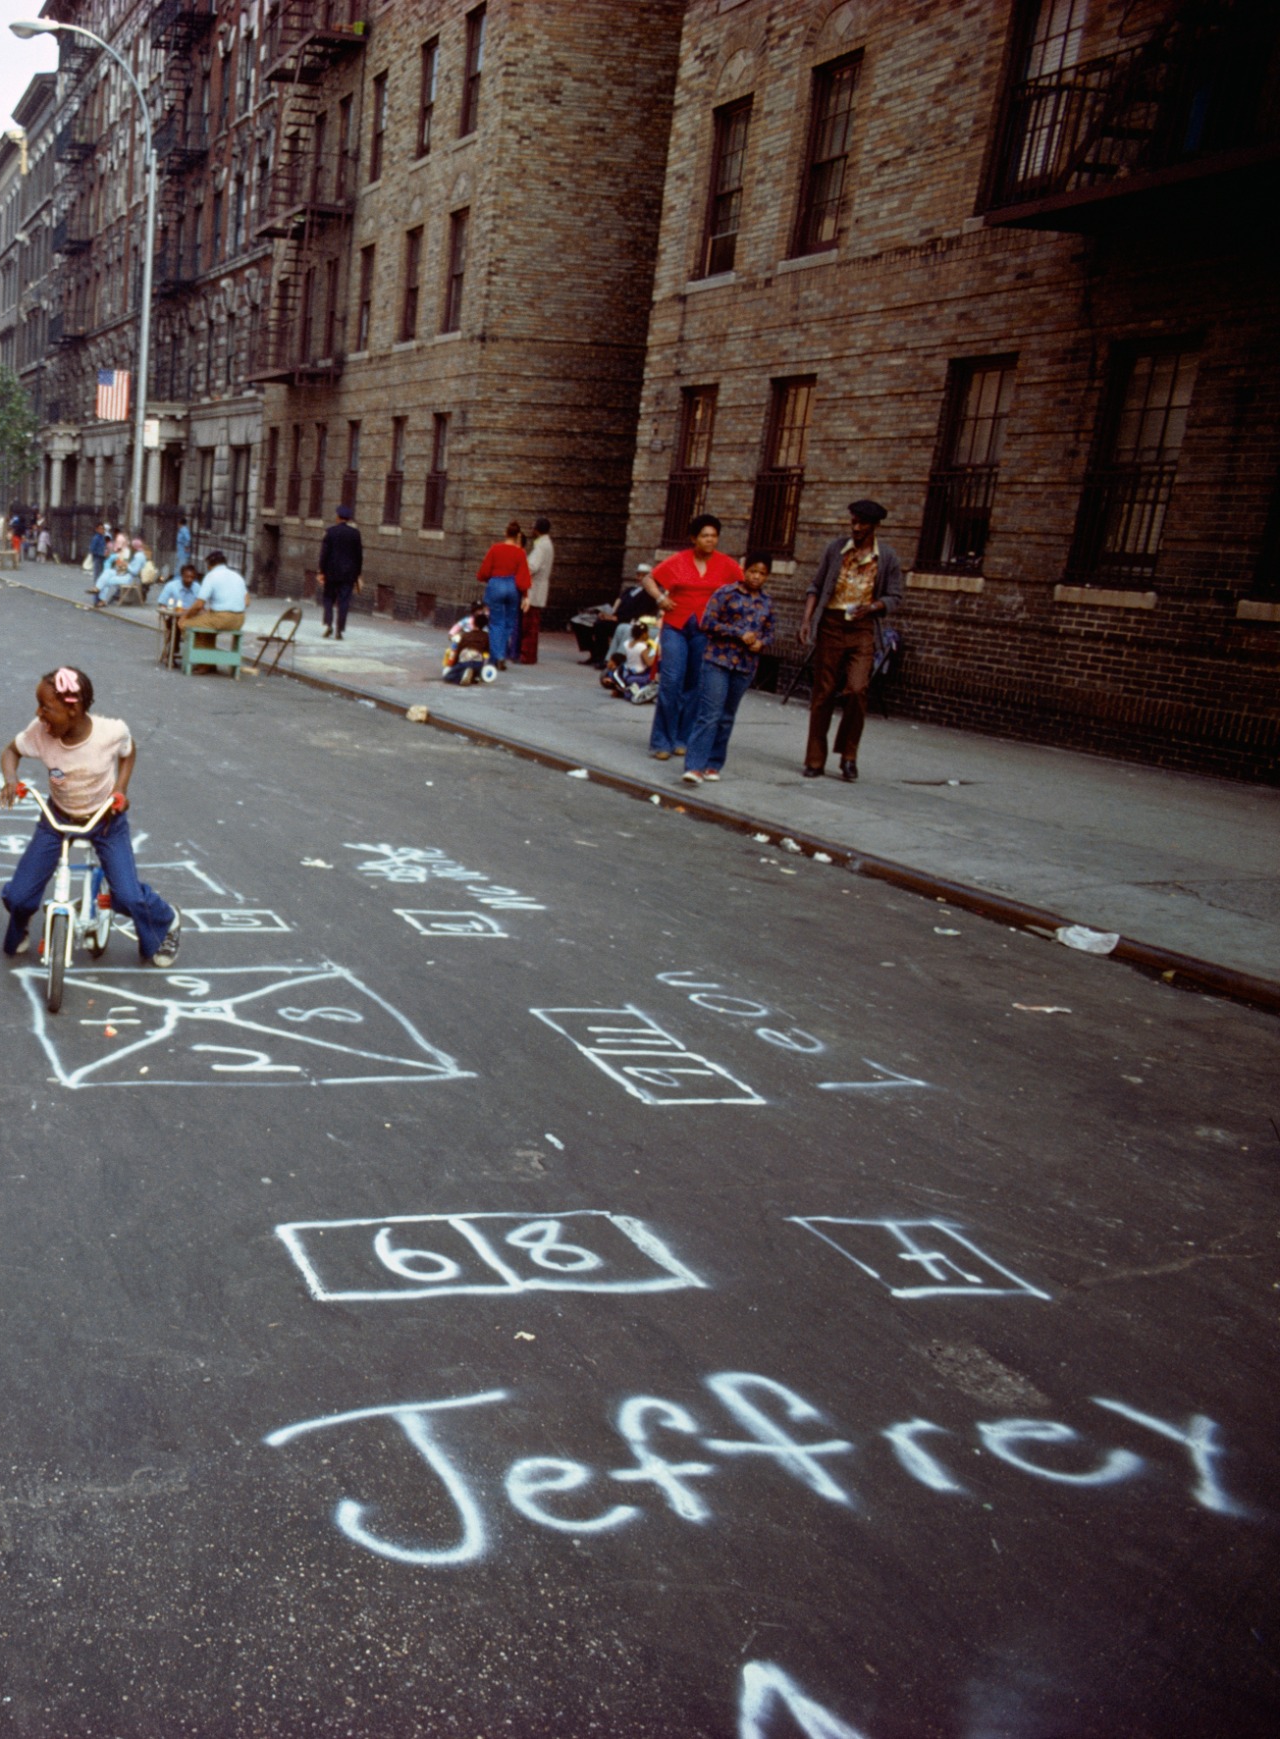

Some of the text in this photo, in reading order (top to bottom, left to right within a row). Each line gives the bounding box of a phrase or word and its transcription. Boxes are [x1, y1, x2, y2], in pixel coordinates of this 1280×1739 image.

[277, 1006, 365, 1023] 8
[374, 1219, 604, 1283] 6 8
